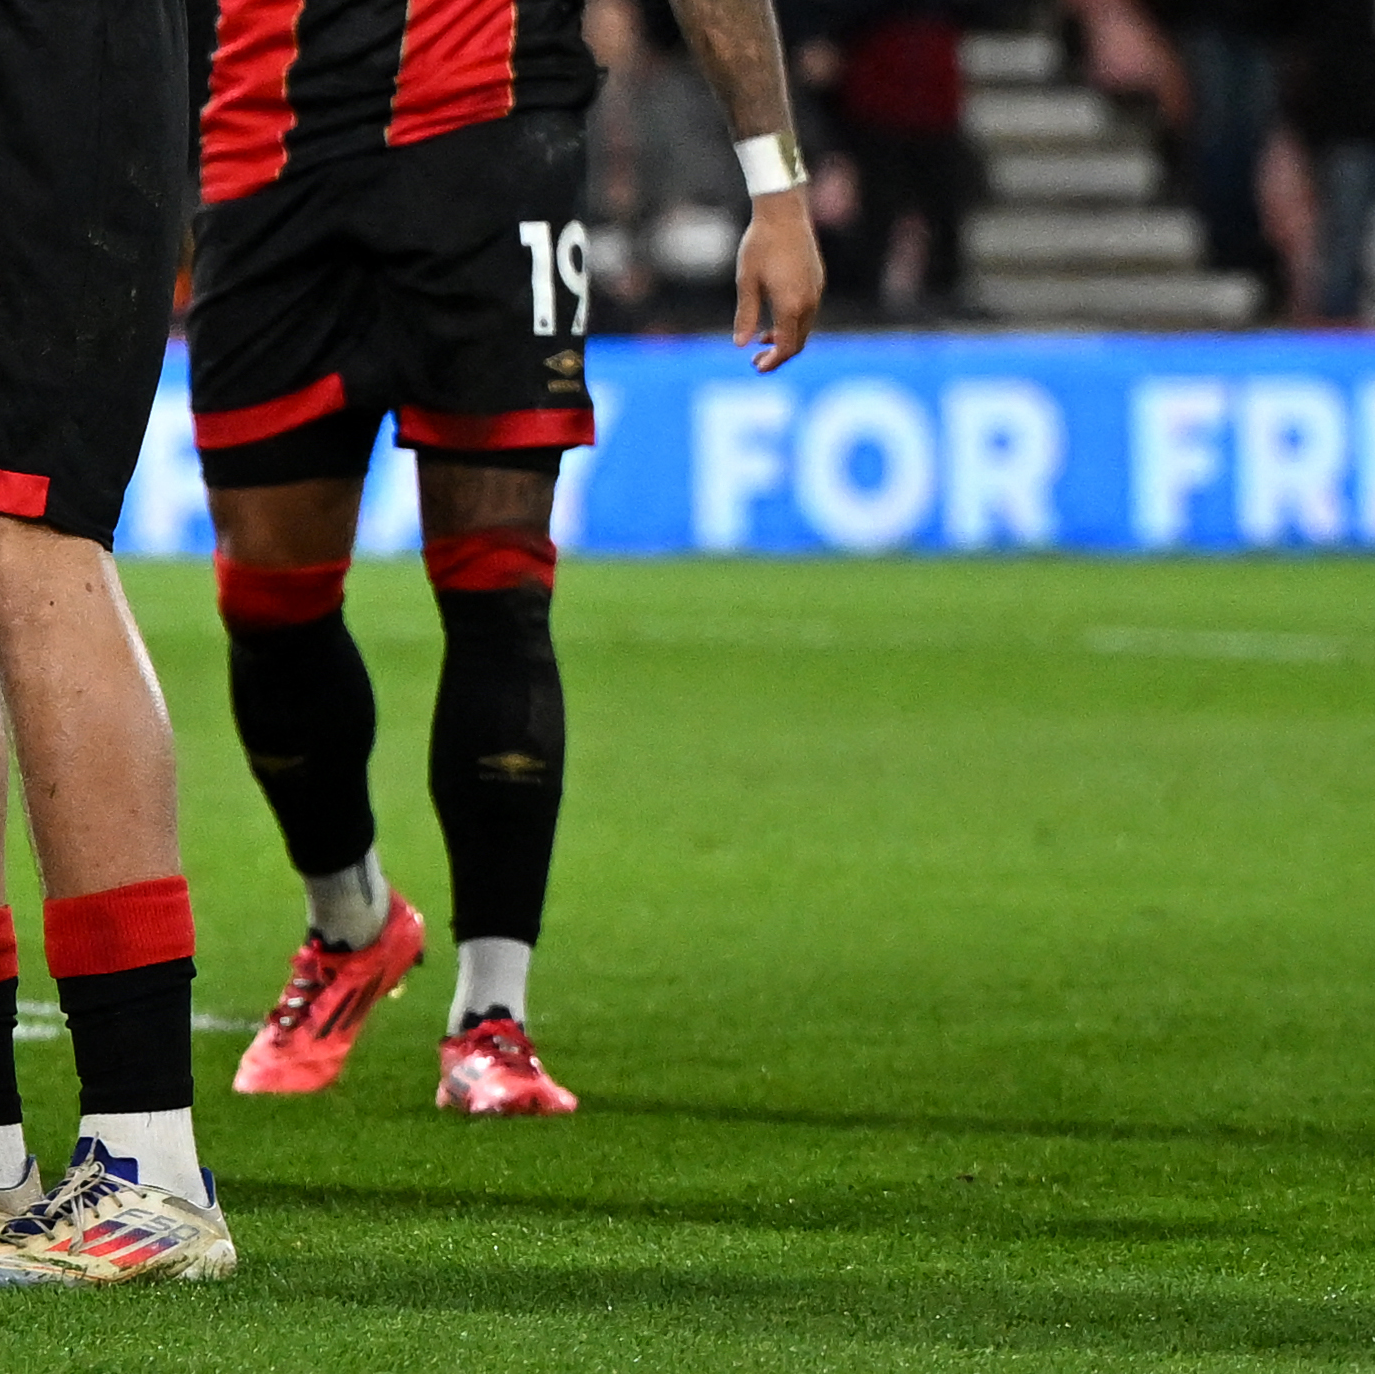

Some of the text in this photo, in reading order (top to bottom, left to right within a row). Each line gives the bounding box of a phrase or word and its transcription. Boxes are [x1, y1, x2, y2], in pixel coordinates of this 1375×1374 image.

[518, 219, 591, 337] 19
[691, 375, 1063, 551] FOR
[1128, 375, 1375, 546] FR
[112, 1208, 200, 1242] F50
